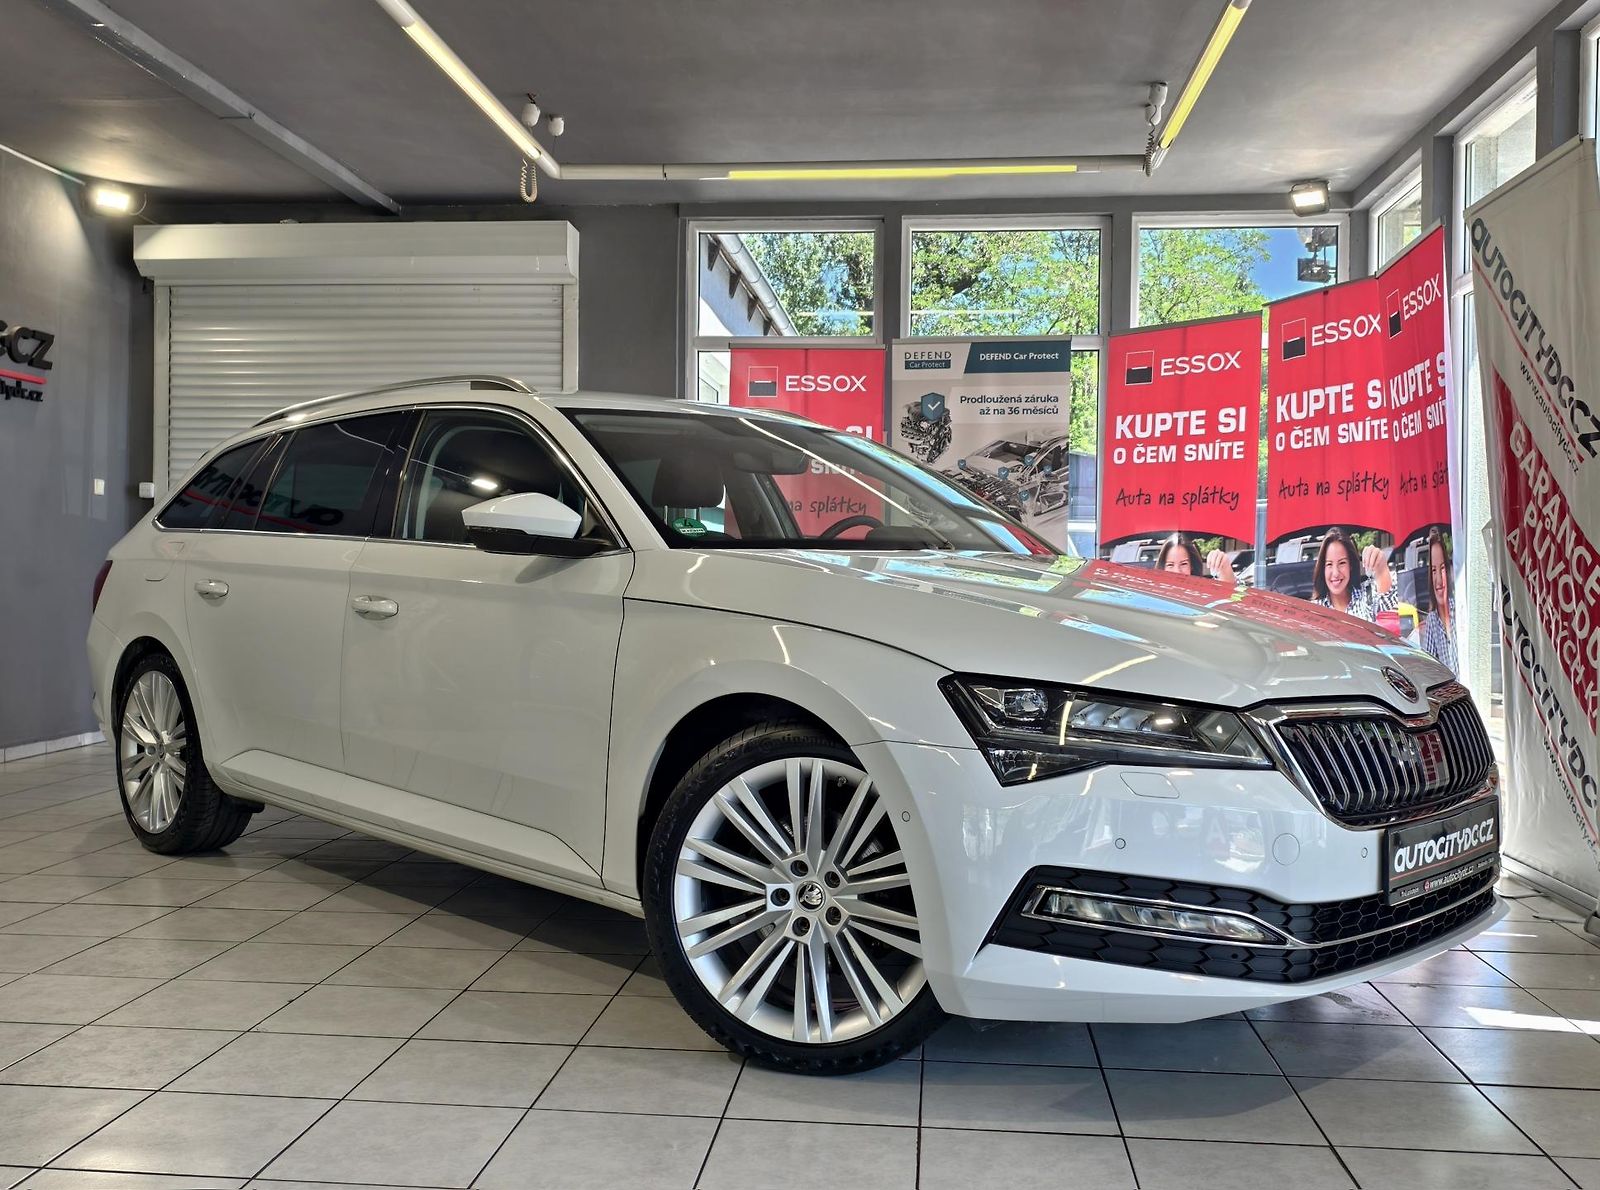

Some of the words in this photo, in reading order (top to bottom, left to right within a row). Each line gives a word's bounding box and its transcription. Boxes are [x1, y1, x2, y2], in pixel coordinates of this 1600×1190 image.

[1403, 273, 1441, 321] ESSOX
[1311, 313, 1382, 347] ESSOX
[904, 351, 952, 360] DEFEND
[922, 361, 946, 369] Protect
[979, 352, 1011, 361] DEFEND
[1013, 352, 1027, 360] Car
[1028, 351, 1059, 360] Protect
[1160, 350, 1242, 377] ESSOX
[785, 375, 867, 392] ESSOX
[1389, 358, 1433, 410] KUPTE
[959, 393, 1022, 404] Prodloužená
[1024, 394, 1059, 404] záruka
[979, 406, 993, 416] až
[1008, 406, 1020, 415] 36
[1022, 405, 1059, 415] měsíců
[1276, 382, 1354, 423] KUPTE
[1115, 409, 1207, 440] KUPTE
[1217, 406, 1247, 434] SI
[1275, 432, 1285, 452] O
[1290, 425, 1330, 450] ČEM
[1337, 415, 1389, 444] SNÍTE
[1392, 419, 1400, 442] O
[1401, 409, 1422, 439] ČEM
[1113, 447, 1127, 465] O
[1132, 443, 1177, 464] ČEM
[1184, 439, 1245, 462] SNÍTE
[1115, 487, 1152, 506] Auta
[1158, 494, 1175, 506] na
[1181, 485, 1240, 511] splátky
[1278, 477, 1309, 499] Auta
[1316, 480, 1331, 496] na
[1337, 470, 1390, 501] splátky
[809, 495, 867, 518] splátky
[1509, 421, 1600, 607] GARANCE
[1507, 527, 1520, 554] A
